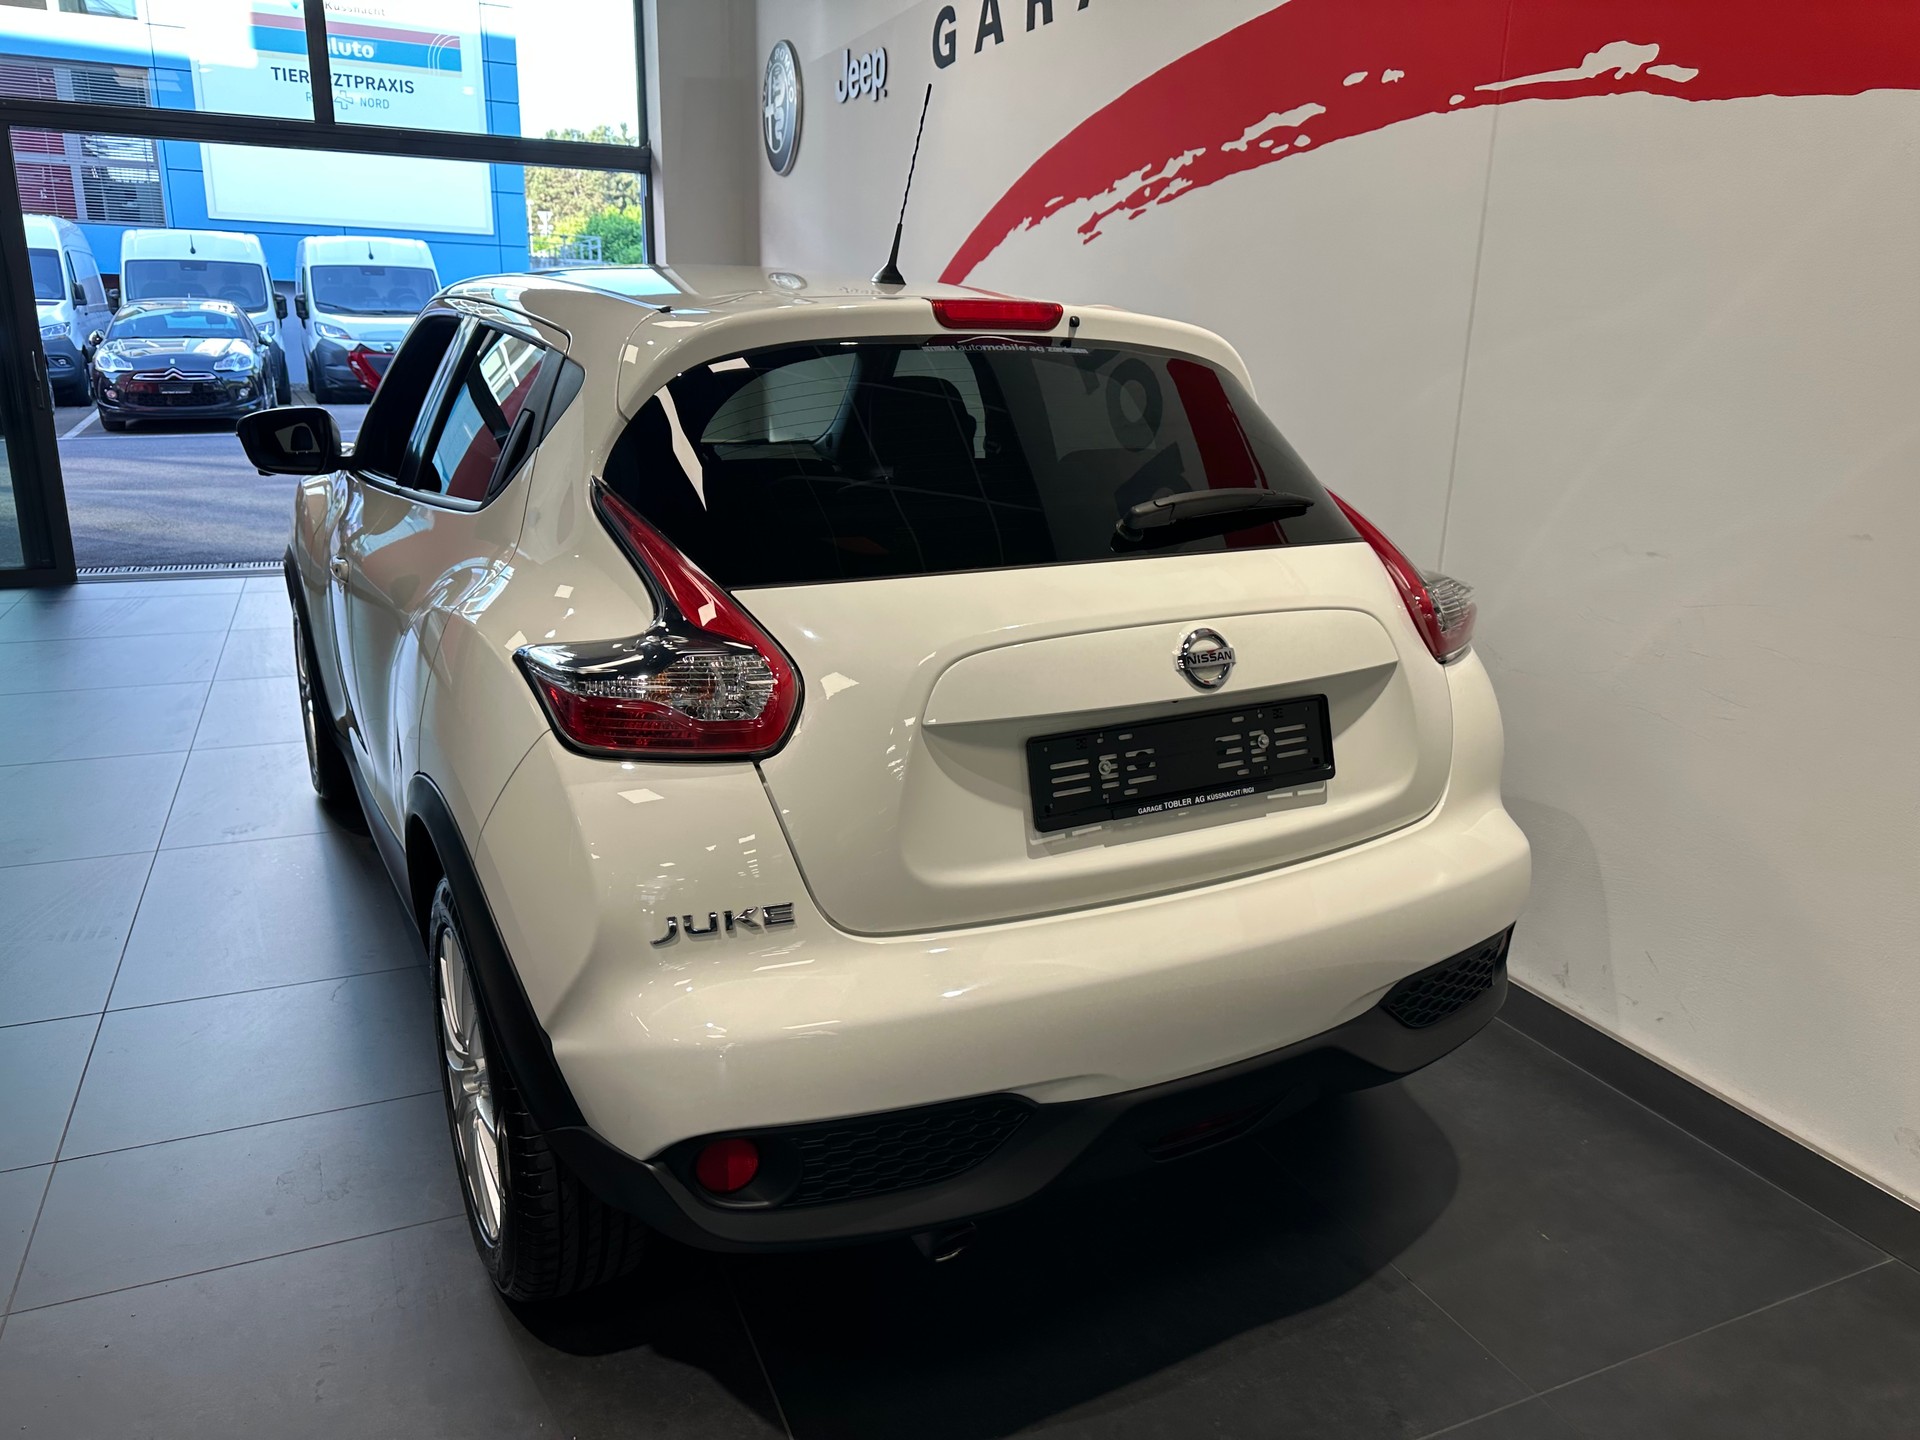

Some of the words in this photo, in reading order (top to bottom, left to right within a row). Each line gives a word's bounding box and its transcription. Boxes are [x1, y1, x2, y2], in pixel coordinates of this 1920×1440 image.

[329, 37, 375, 59] luto
[270, 66, 415, 94] TIERZTPRAXIS
[835, 46, 887, 103] Jeep
[360, 97, 390, 109] NORD
[959, 344, 1027, 352] automobile
[1186, 650, 1232, 665] NISSAN
[1137, 804, 1163, 815] GARAGE
[1164, 797, 1192, 809] TOBLER
[1195, 795, 1206, 804] AG
[650, 902, 795, 946] JUKE
